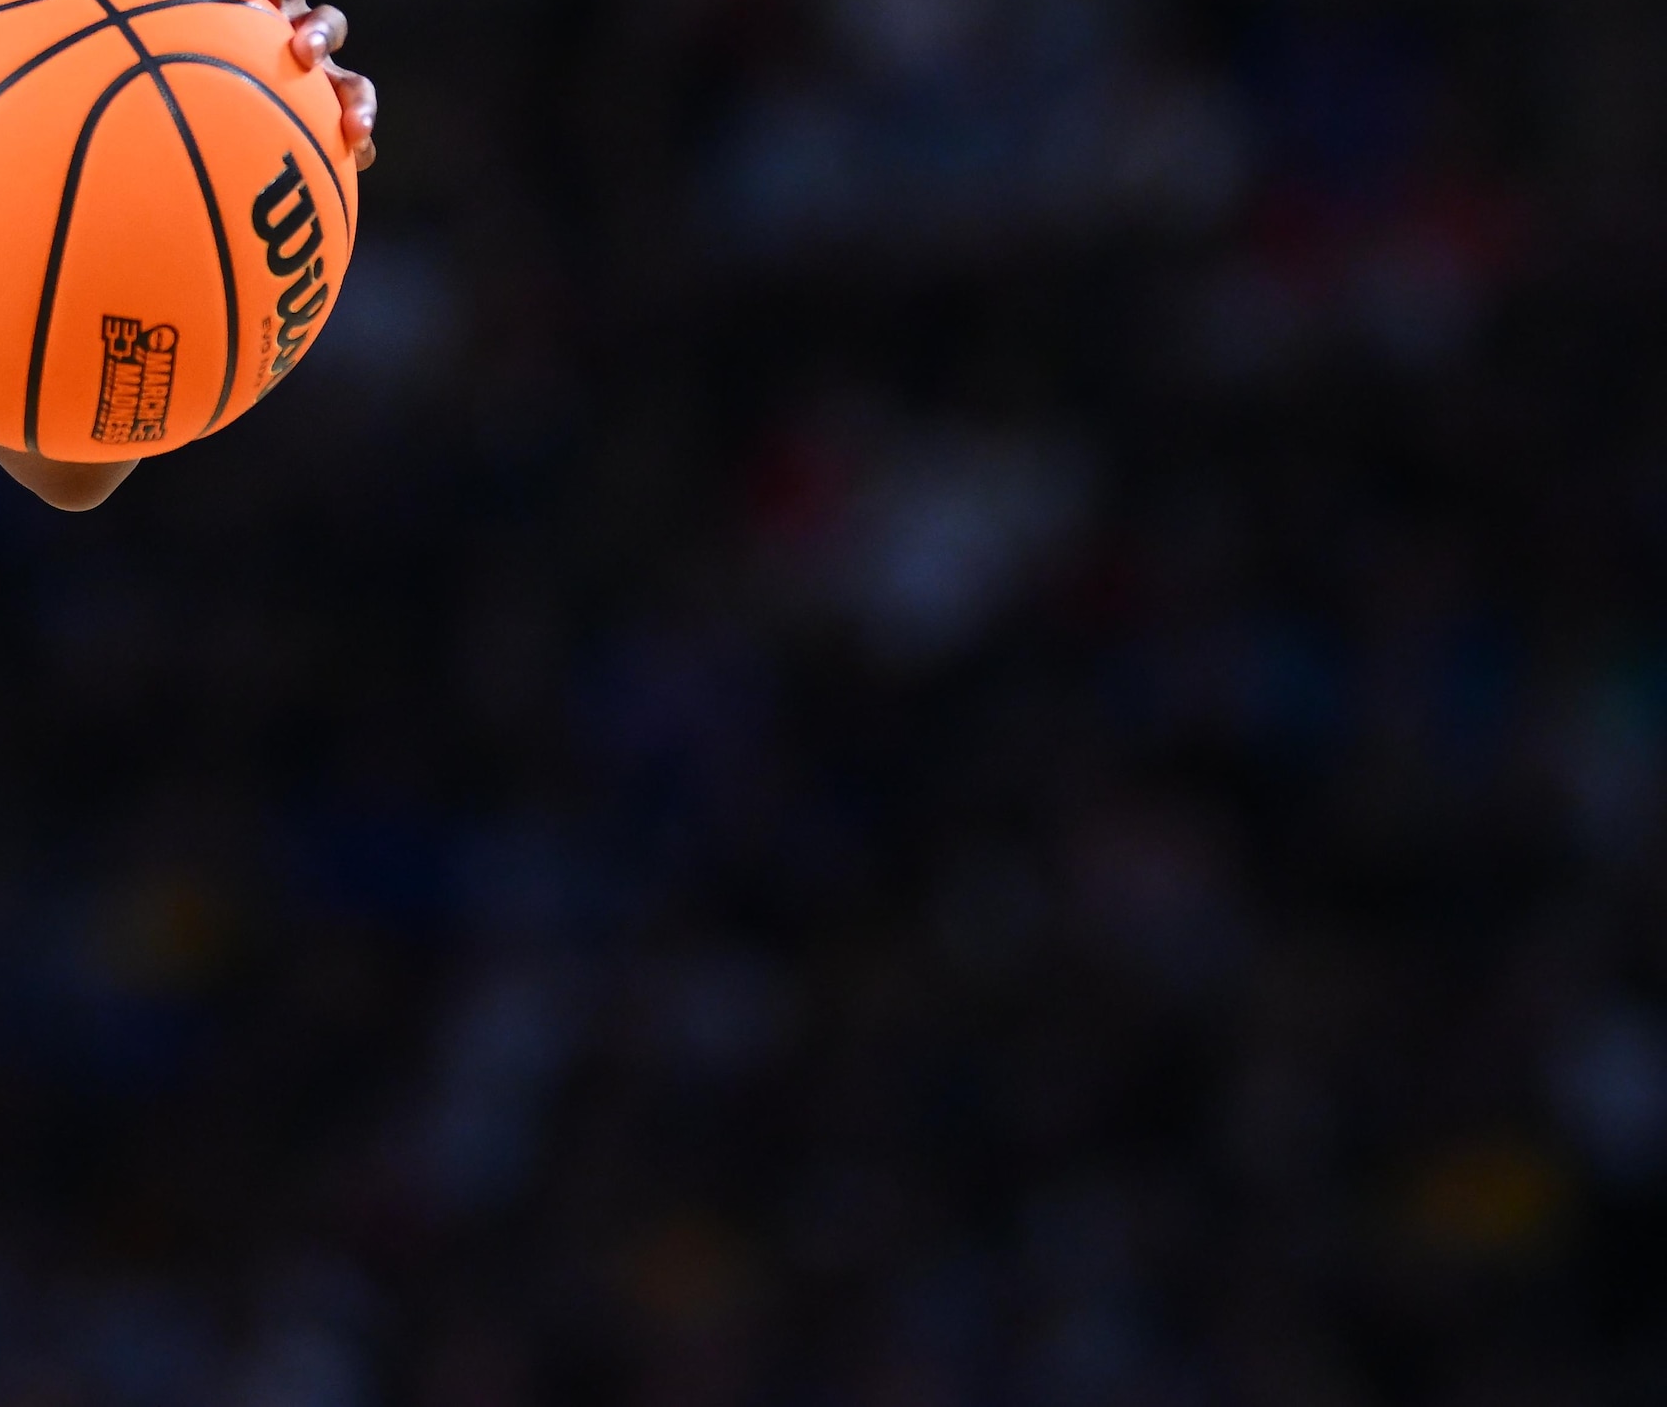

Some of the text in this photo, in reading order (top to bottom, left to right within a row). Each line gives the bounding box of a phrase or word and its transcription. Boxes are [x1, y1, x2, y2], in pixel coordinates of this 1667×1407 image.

[251, 151, 329, 404] Wils
[101, 362, 142, 443] MADNESS
[137, 351, 173, 421] MARCH
